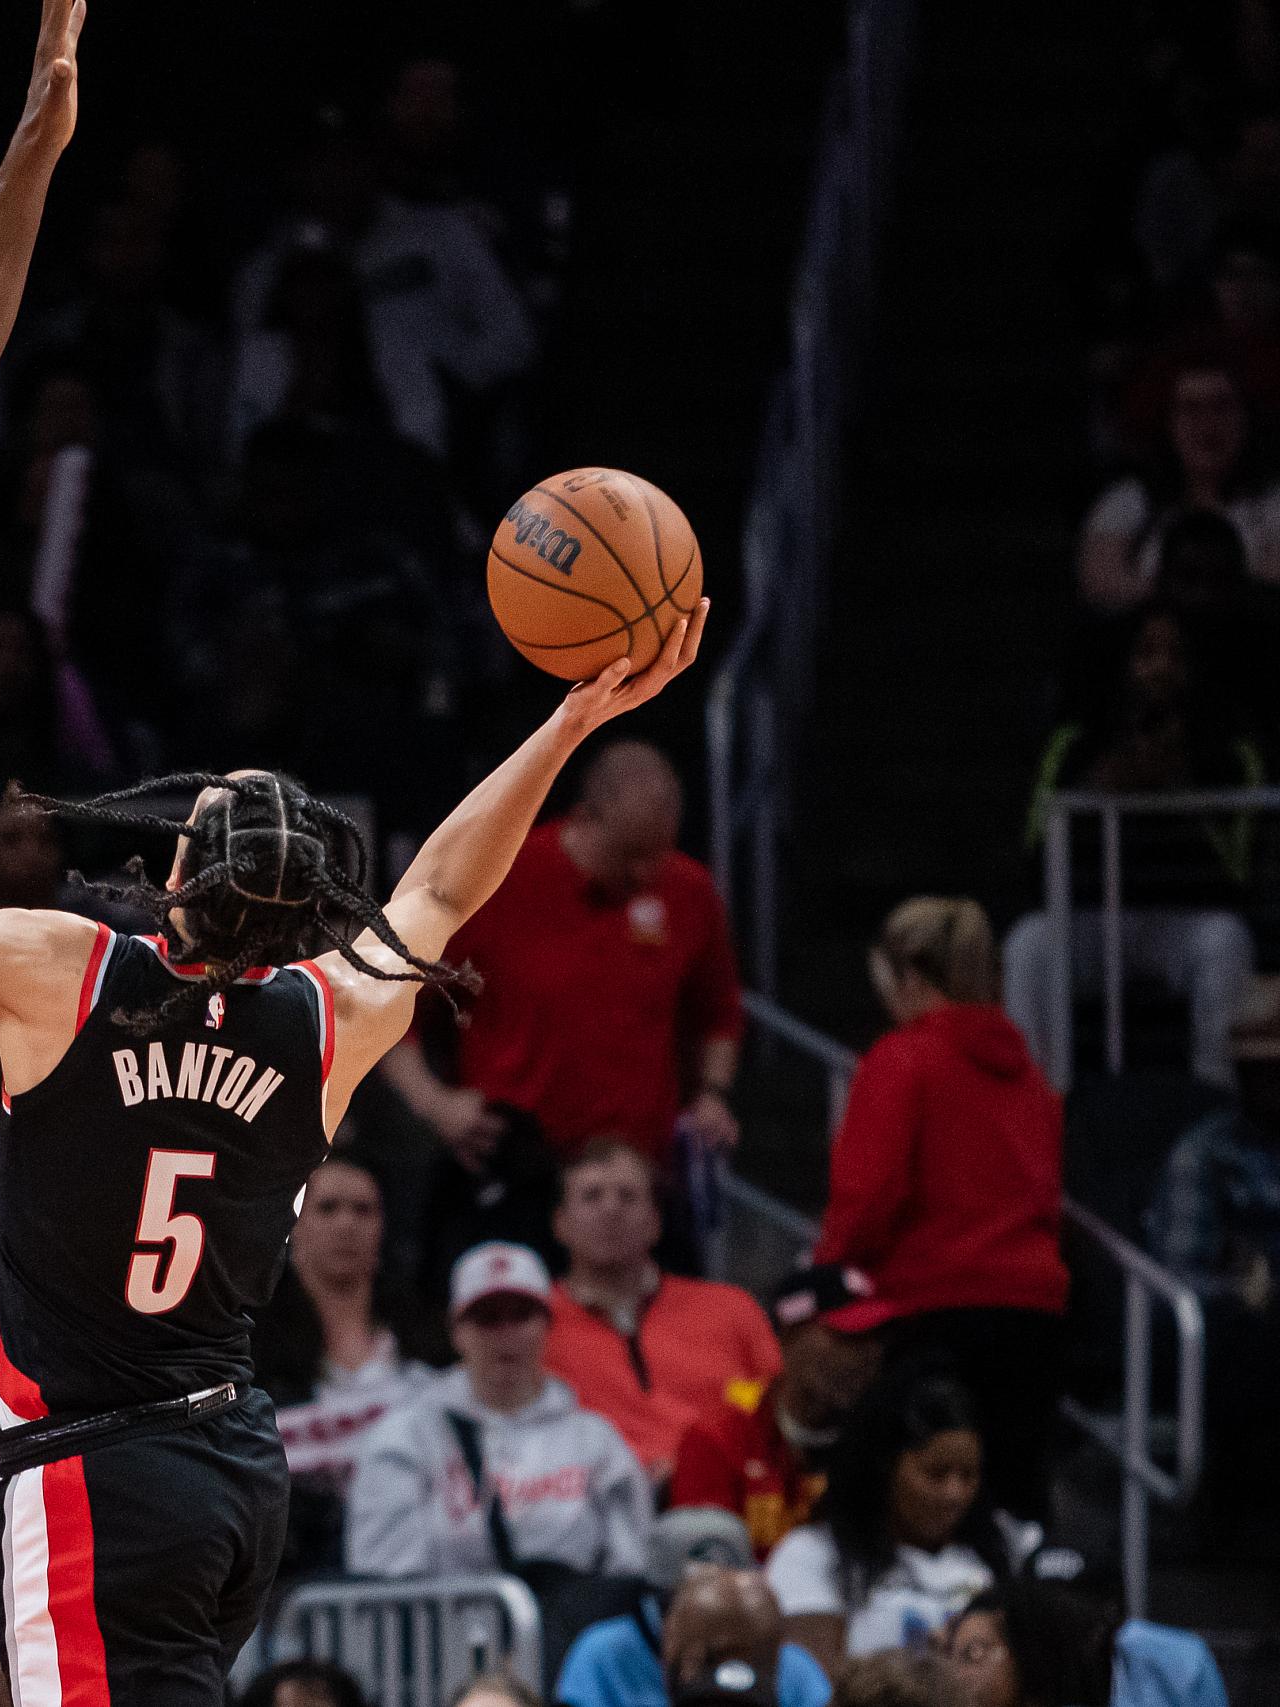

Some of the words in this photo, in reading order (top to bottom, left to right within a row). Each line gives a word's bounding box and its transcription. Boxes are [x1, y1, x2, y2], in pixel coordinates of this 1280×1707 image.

[506, 500, 581, 576] Wilso
[112, 1042, 285, 1123] BANTON
[125, 1147, 217, 1314] 5
